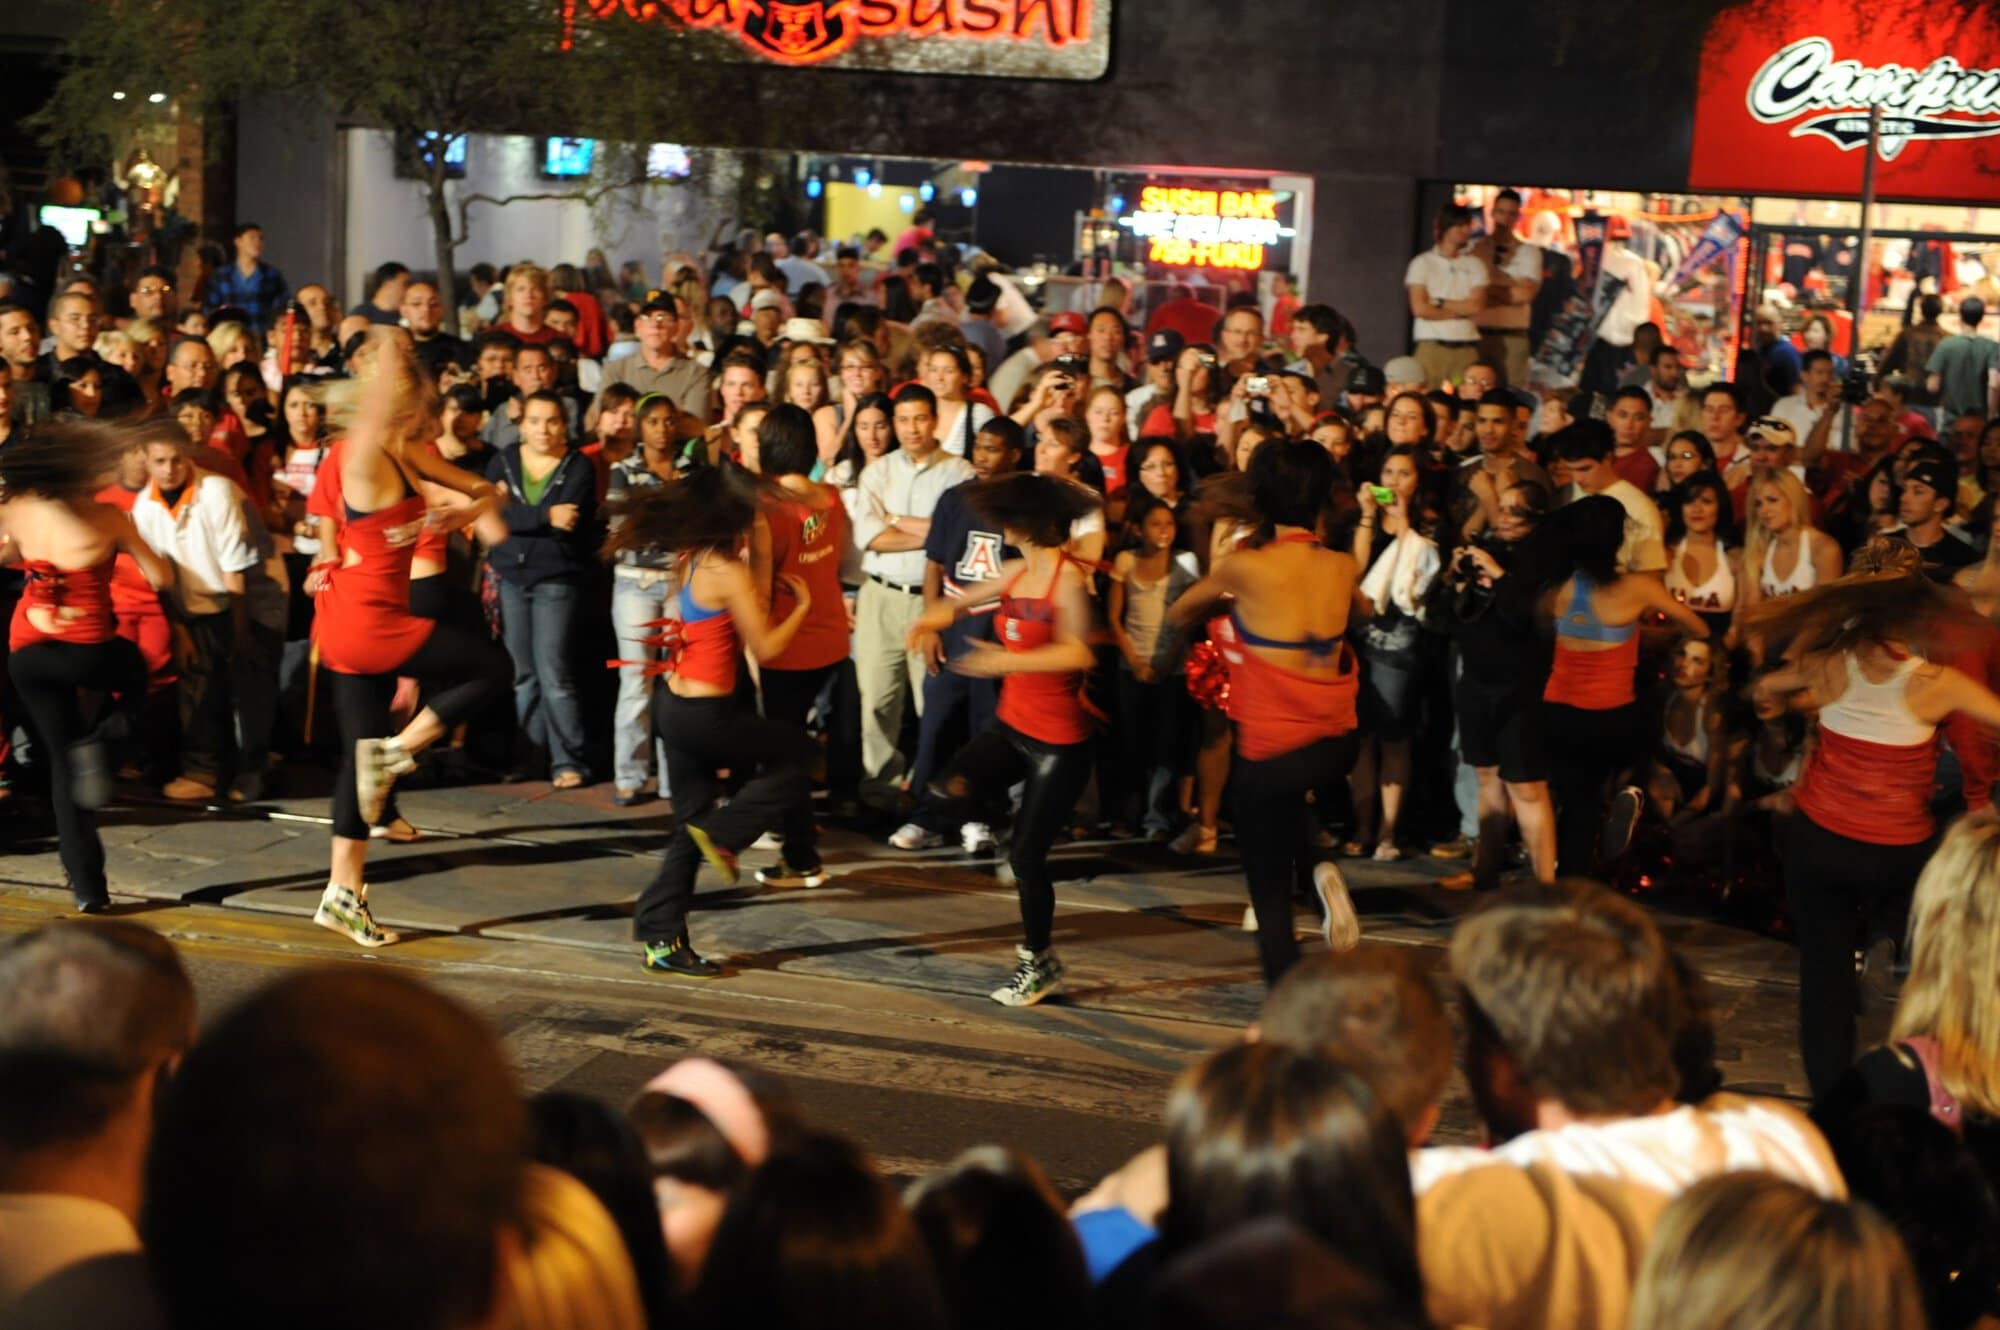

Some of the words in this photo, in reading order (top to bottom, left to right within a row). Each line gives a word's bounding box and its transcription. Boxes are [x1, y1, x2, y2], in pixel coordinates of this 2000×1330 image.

[1747, 36, 2000, 161] Campu
[1139, 186, 1219, 217] SUSHI
[1220, 190, 1276, 219] BAR
[955, 529, 1003, 582] A
